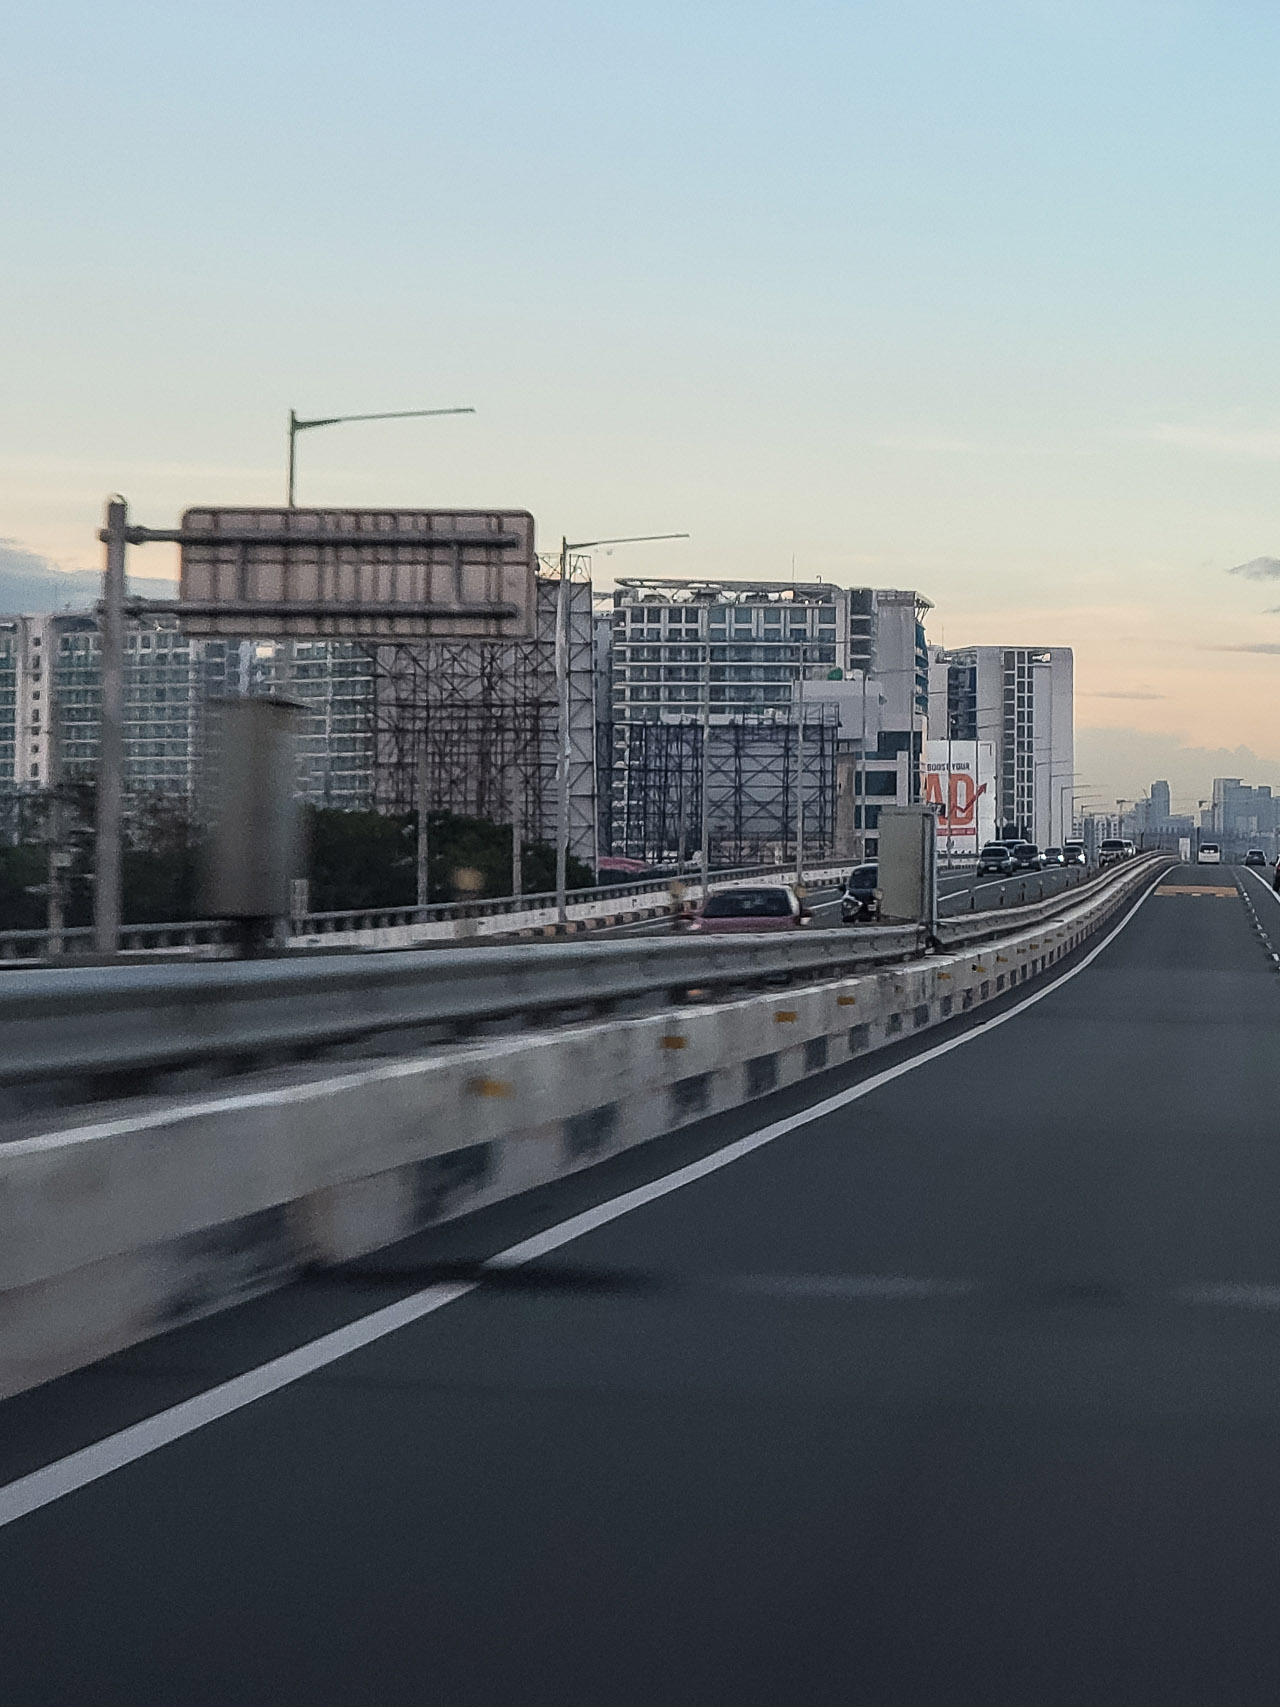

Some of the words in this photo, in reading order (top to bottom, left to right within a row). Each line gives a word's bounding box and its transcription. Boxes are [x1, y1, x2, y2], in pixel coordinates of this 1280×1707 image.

[927, 763, 950, 771] BOOST
[951, 762, 970, 770] YOUR
[925, 772, 975, 825] AD
